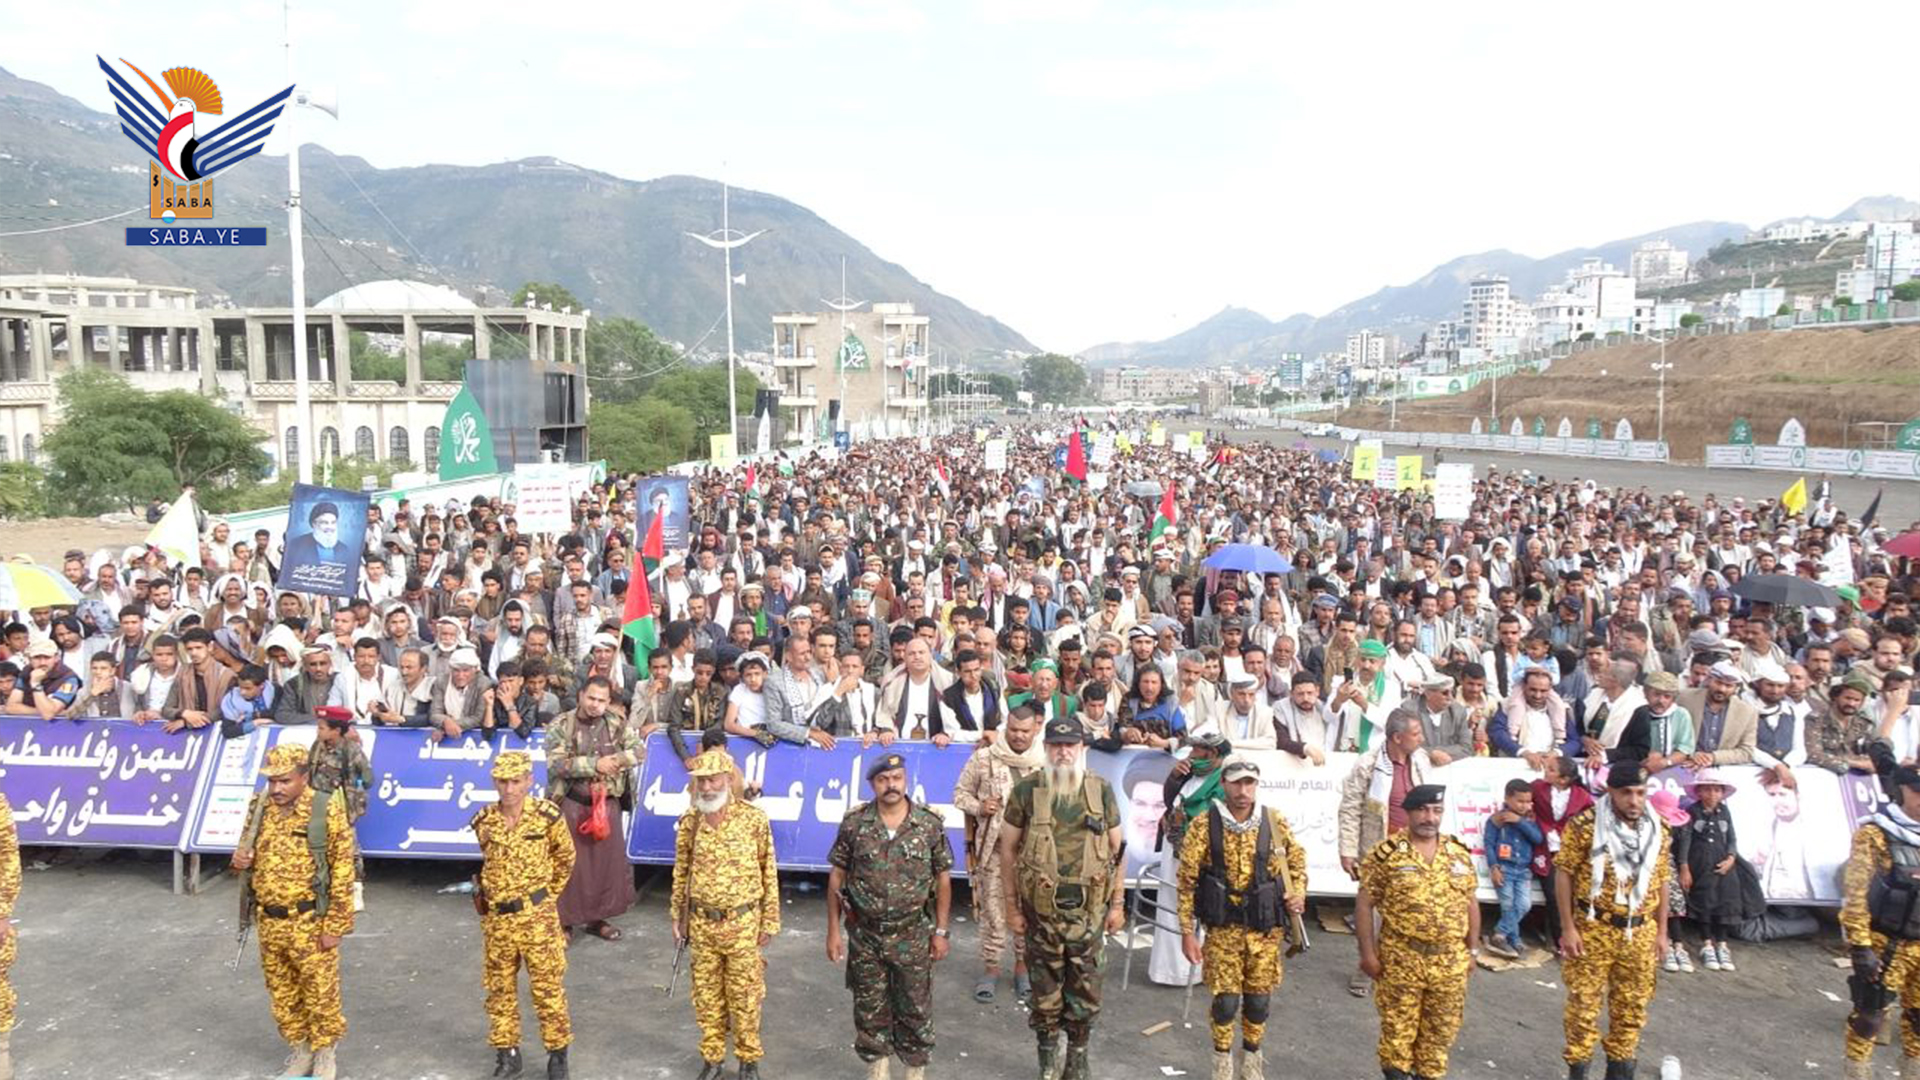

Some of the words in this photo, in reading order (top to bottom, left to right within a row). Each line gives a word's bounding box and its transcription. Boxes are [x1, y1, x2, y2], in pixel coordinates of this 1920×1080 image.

[0, 729, 118, 781] وفلسطي
[119, 734, 204, 782] اليمن
[419, 737, 493, 767] جهاد
[13, 787, 67, 836] واح
[67, 786, 182, 837] خندق
[378, 774, 453, 806] غزة
